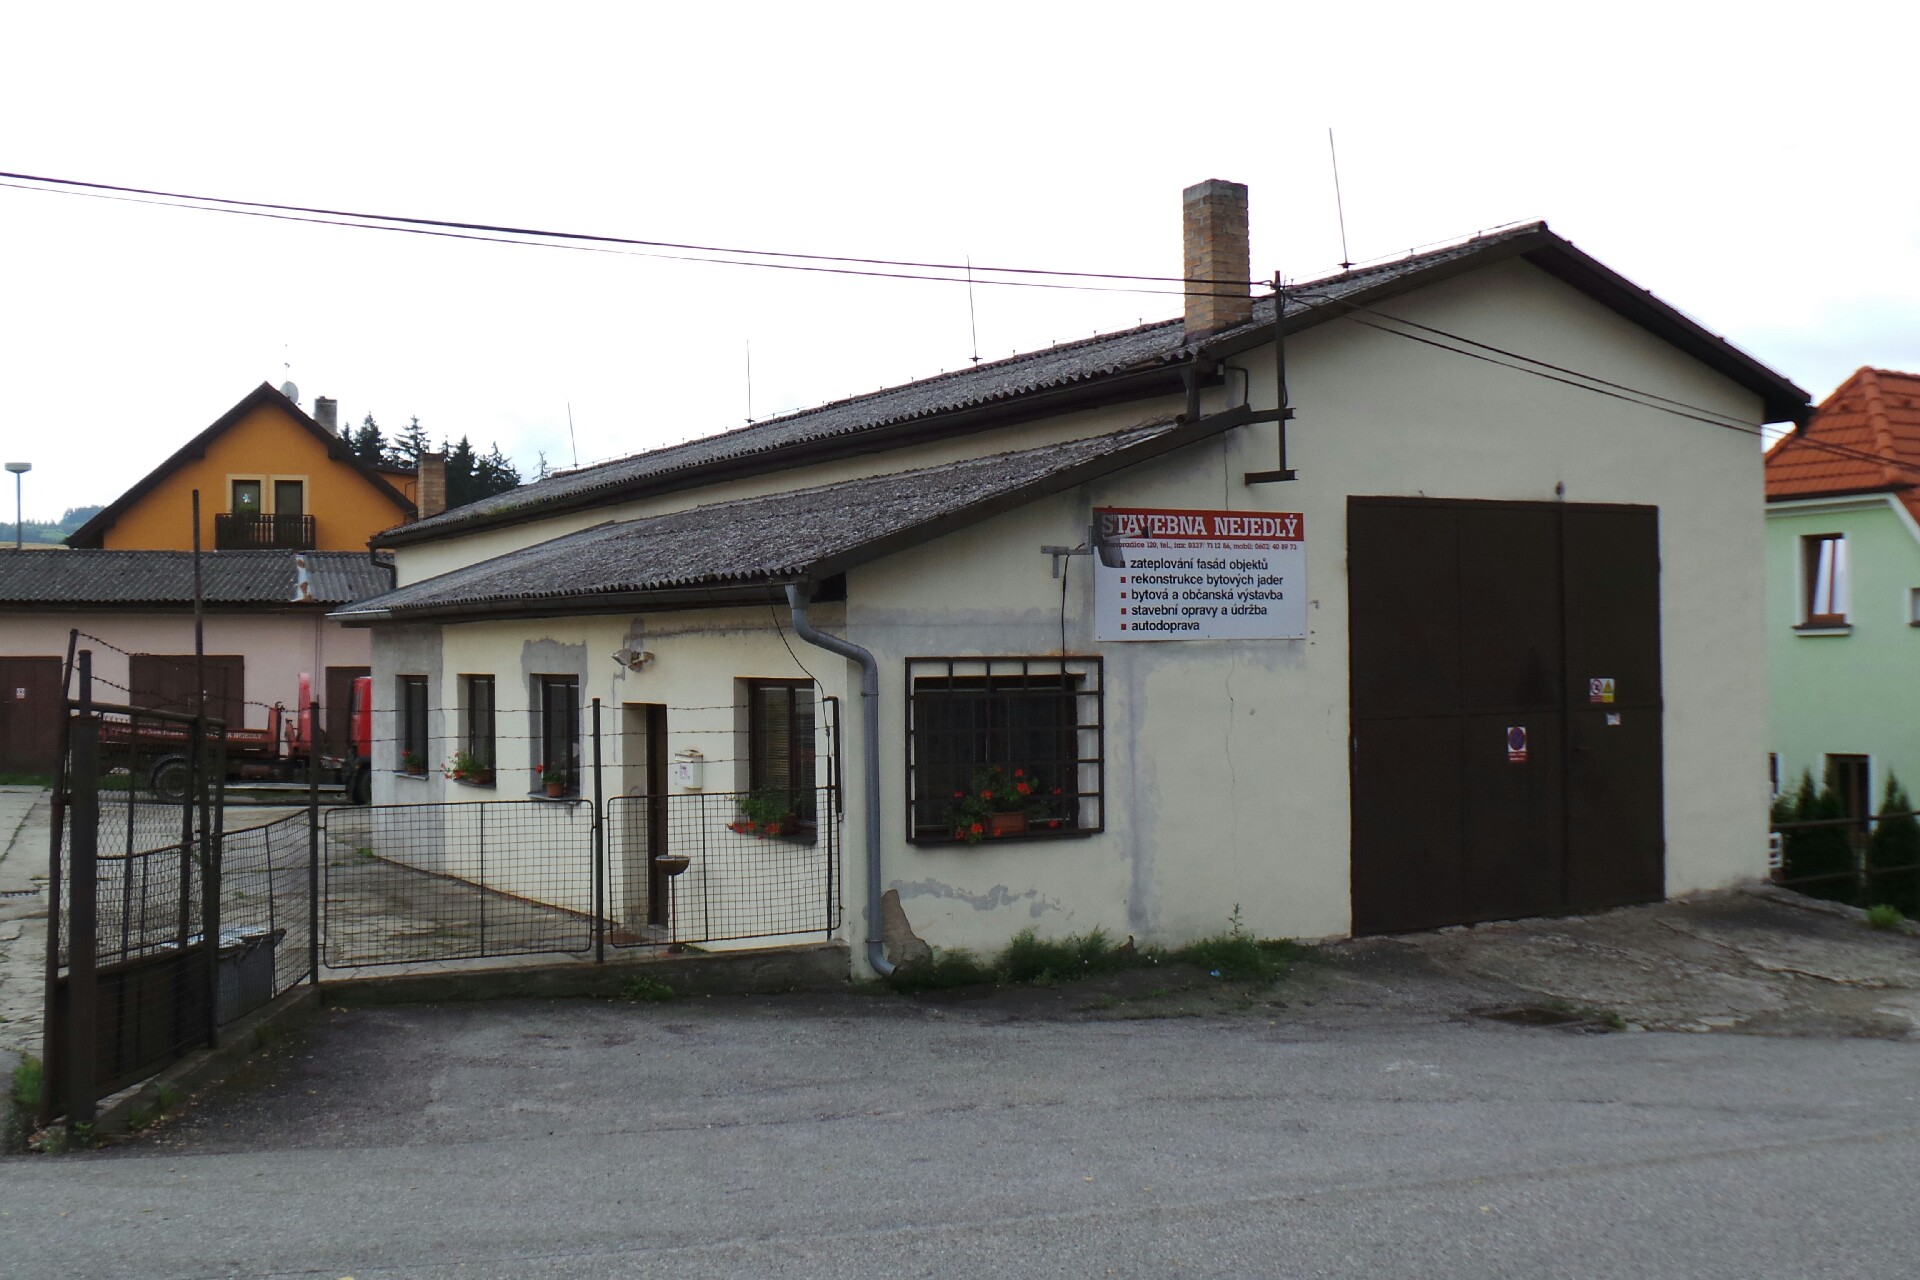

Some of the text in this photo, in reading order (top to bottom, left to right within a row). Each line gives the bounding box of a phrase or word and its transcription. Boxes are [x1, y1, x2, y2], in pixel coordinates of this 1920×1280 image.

[1103, 514, 1298, 537] STAVEBNA NEJEDLÝ
[1130, 557, 1268, 573] zateplování fasád objektů
[1131, 573, 1283, 587] rekonstrukce bytových jader
[1131, 588, 1283, 602] bytová a občanská výstavba
[1131, 603, 1267, 618] stavební opravy a údržba
[1132, 620, 1200, 633] autodoprava
